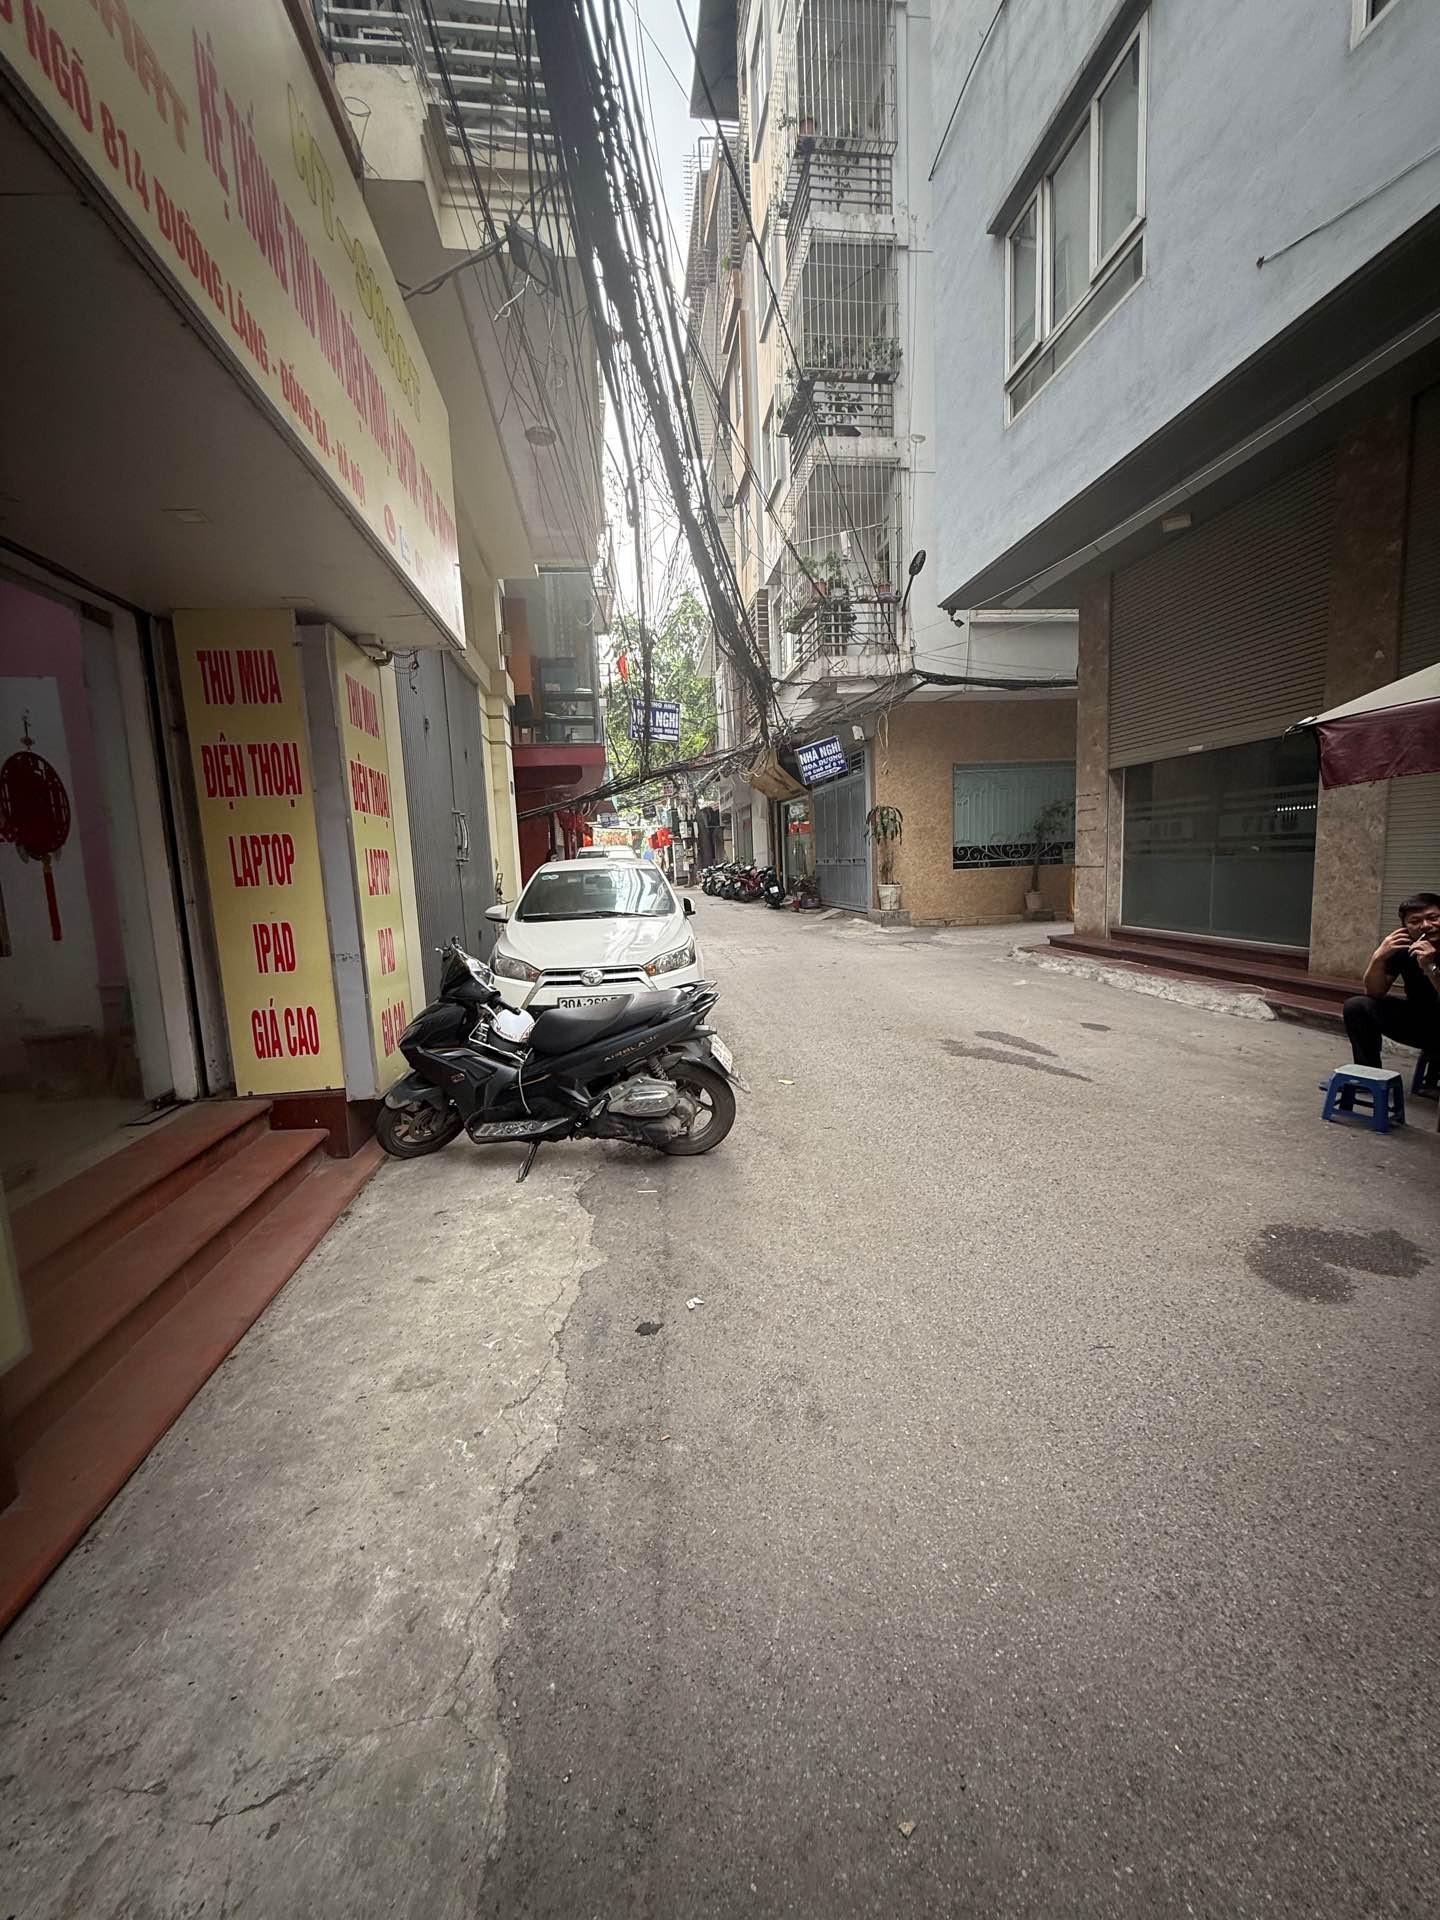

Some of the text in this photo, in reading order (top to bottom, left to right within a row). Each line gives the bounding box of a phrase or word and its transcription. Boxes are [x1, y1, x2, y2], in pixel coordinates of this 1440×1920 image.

[88, 0, 189, 154] ART
[22, 0, 94, 133] NGÕ
[100, 101, 150, 213] 814
[153, 175, 225, 316] ĐƯỜNG
[226, 280, 269, 376] LÁNG
[192, 24, 230, 223] HỆ
[224, 86, 288, 295] THỐNG
[283, 201, 316, 339] THU
[313, 257, 344, 387] MUA
[196, 650, 282, 705] THU MUA
[345, 672, 380, 740] THU MUA
[201, 732, 303, 810] ĐIỆN THOẠI
[800, 747, 819, 765] NHÀ
[350, 752, 391, 828] ĐIỆN THOẠI
[229, 834, 295, 887] LAPTOP
[364, 847, 390, 896] LAPTOP
[253, 922, 296, 973] IPAD
[378, 928, 396, 976] IPAD
[251, 998, 320, 1059] GIÁ CAO
[382, 998, 407, 1058] GIÁ CAO
